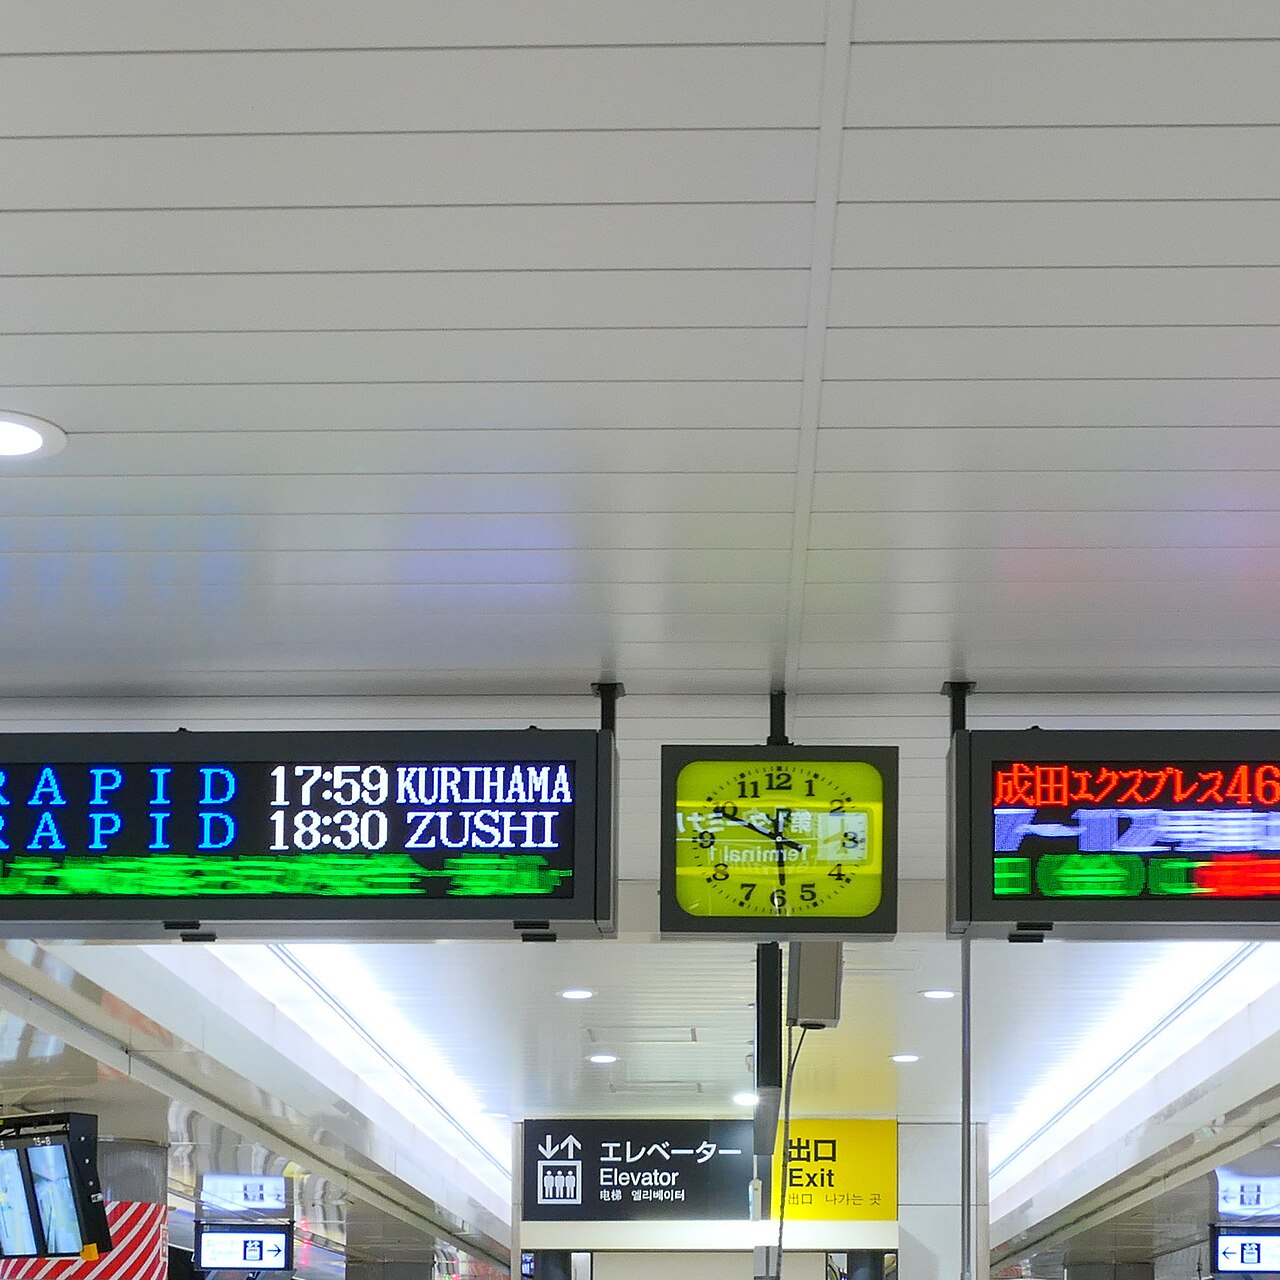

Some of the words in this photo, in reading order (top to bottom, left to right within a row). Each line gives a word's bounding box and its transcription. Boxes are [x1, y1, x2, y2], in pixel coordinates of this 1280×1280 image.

[270, 765, 389, 807] 17:59
[396, 764, 573, 806] KURIHAMA
[738, 781, 760, 798] 11
[765, 773, 792, 790] 12
[805, 779, 815, 797] 1
[829, 799, 845, 816] 2
[270, 809, 389, 850] 18:30
[404, 809, 560, 849] ZUSHI
[698, 830, 716, 849] 9
[841, 831, 859, 849] 3
[712, 863, 730, 881] 8
[827, 863, 845, 881] 4
[739, 883, 757, 901] 7
[770, 889, 787, 908] 6
[800, 883, 817, 901] 5
[600, 1140, 742, 1164] エレベーター
[789, 1137, 837, 1163] 出口
[599, 1168, 680, 1186] Elevator
[789, 1168, 835, 1188] Exit
[631, 1188, 685, 1202] 엘리베이터
[789, 1192, 813, 1205] 出口
[825, 1192, 864, 1206] 나가는
[869, 1193, 882, 1206] 곳
